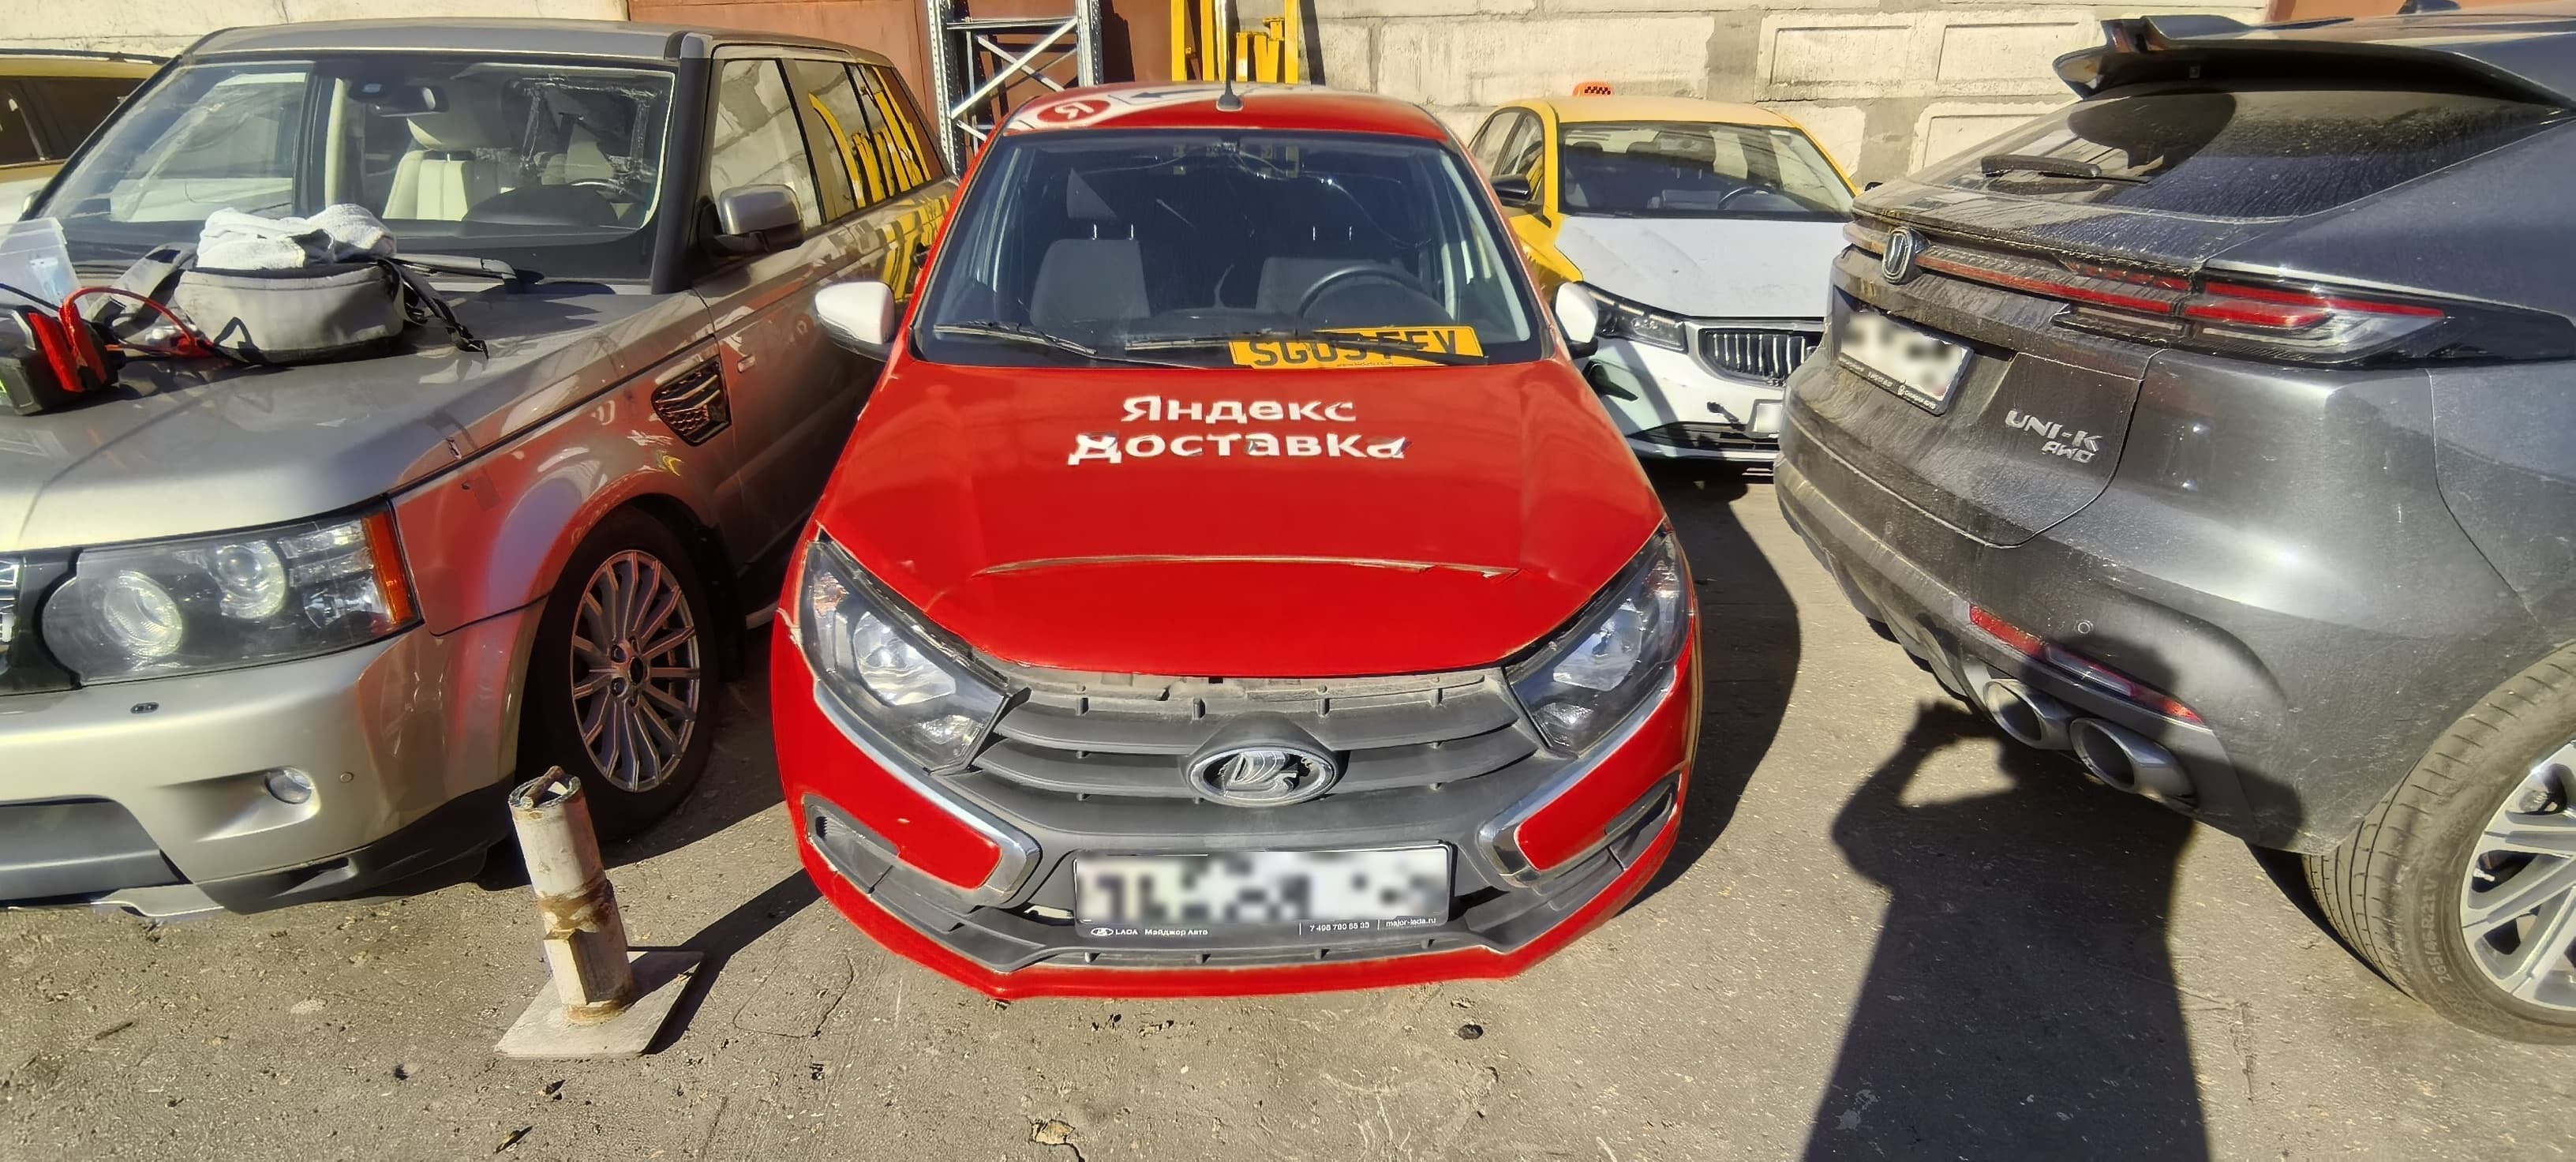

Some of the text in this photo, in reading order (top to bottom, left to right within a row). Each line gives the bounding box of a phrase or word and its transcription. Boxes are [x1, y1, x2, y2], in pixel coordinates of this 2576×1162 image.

[1121, 395, 1357, 424] Яндекс
[2005, 409, 2104, 452] UNI-K
[2041, 440, 2095, 463] AWD
